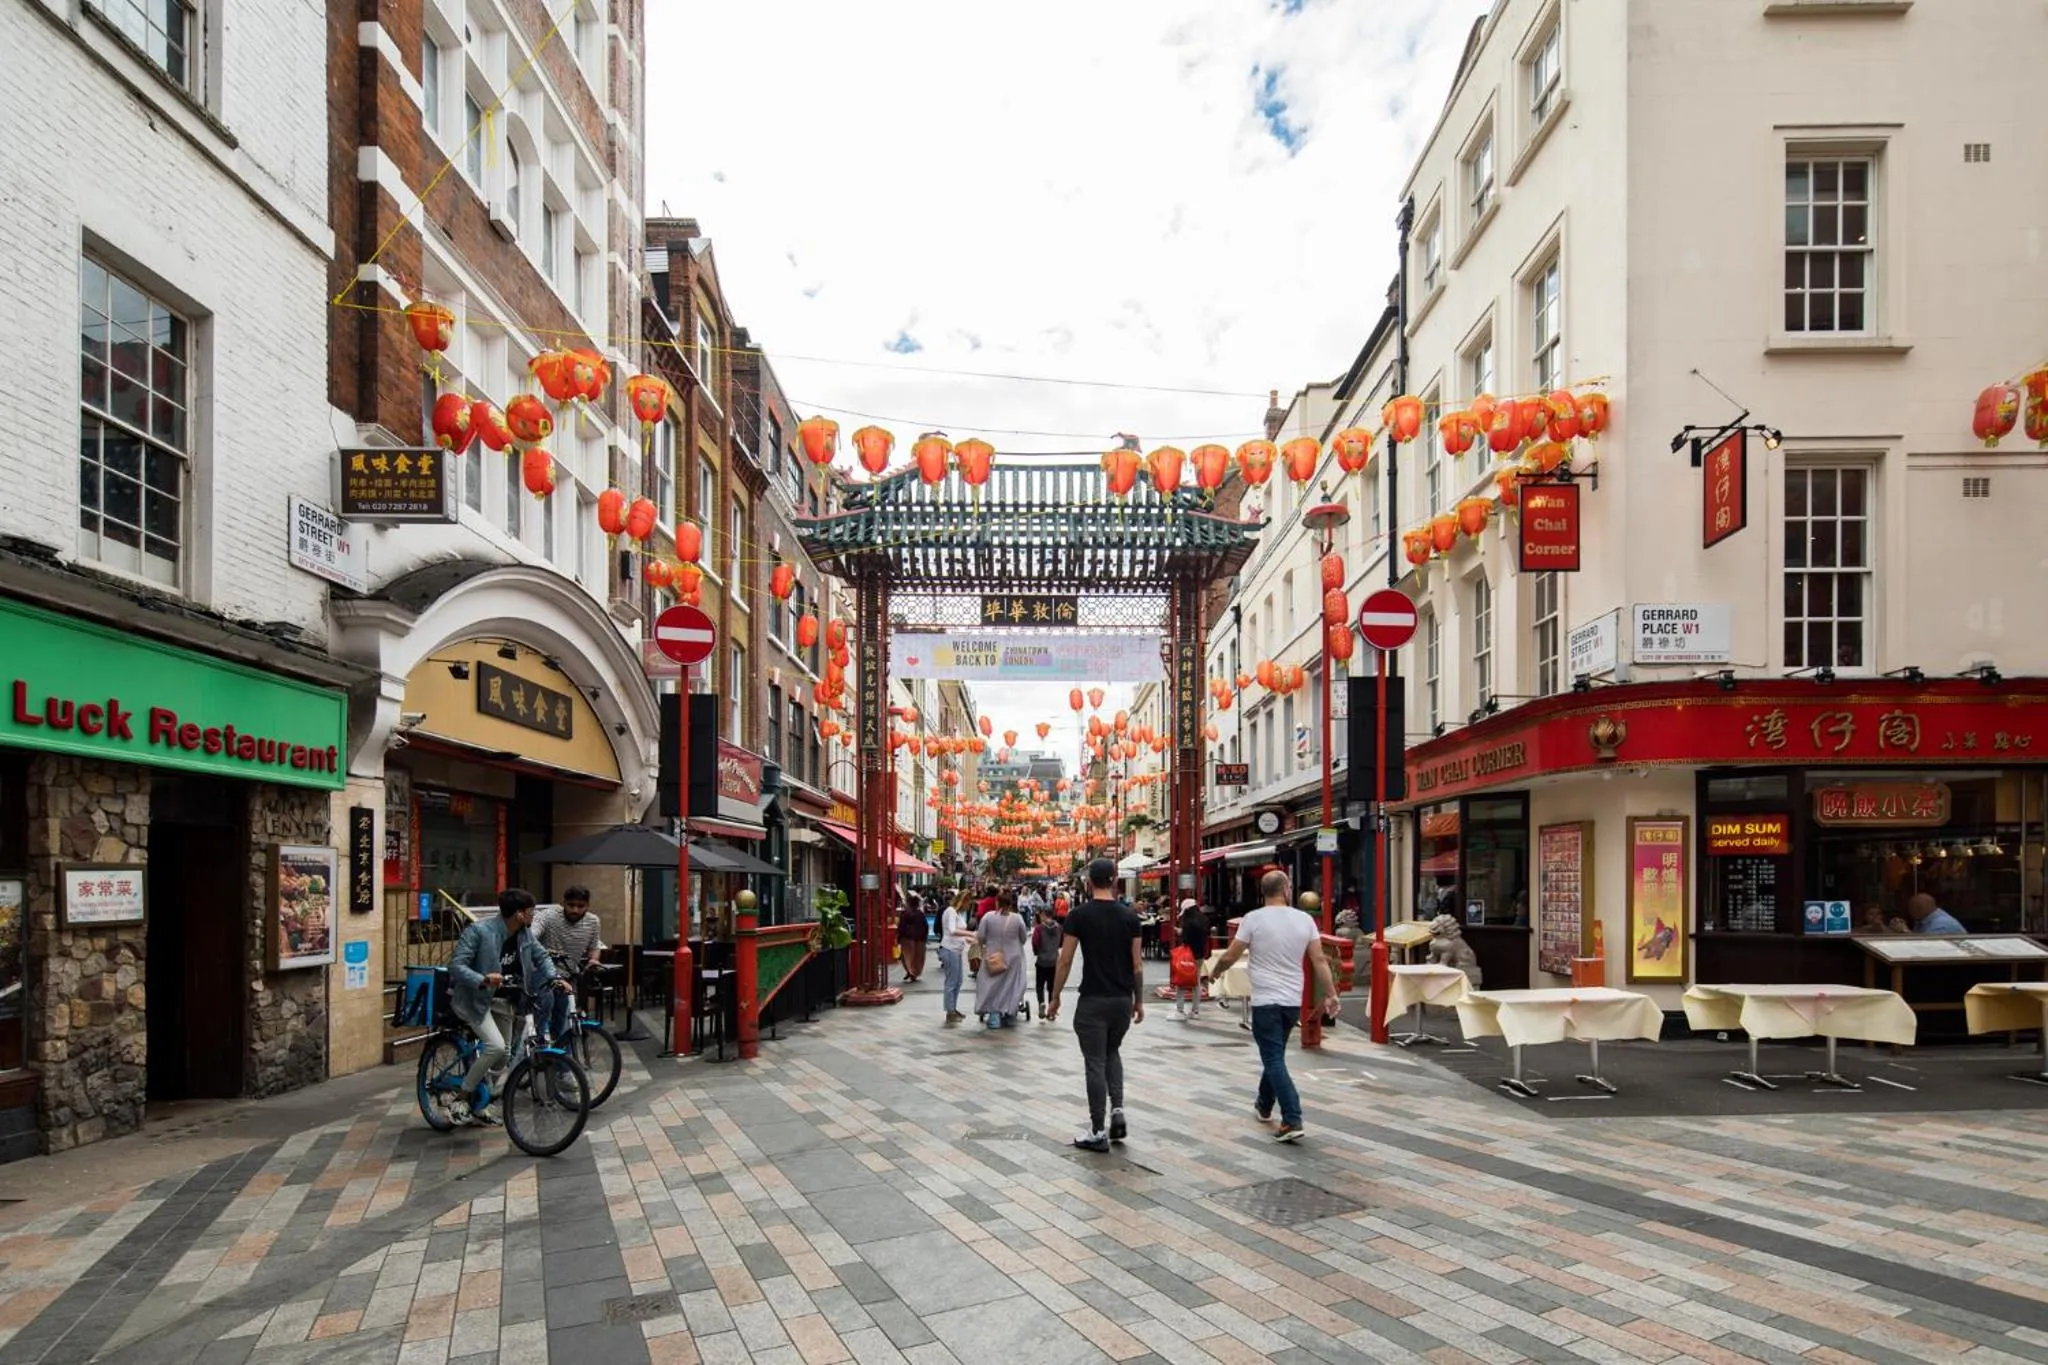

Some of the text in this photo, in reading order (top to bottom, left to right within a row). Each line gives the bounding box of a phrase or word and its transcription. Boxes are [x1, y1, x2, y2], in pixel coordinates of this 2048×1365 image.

[298, 503, 342, 536] GERRARD
[1533, 518, 1567, 531] Chai
[298, 520, 350, 556] STREET W1
[1525, 542, 1576, 555] Corner
[1642, 609, 1698, 621] GERRARD
[1571, 624, 1598, 646] GERRARD
[1642, 623, 1699, 634] PLACE W1
[952, 640, 998, 653] WELCOME
[1571, 639, 1592, 659] STREET
[955, 654, 997, 666] BACK TO
[13, 679, 338, 774] Luck Restaurant
[1441, 758, 1470, 785] CHAI
[1473, 741, 1526, 777] CORNER
[1711, 823, 1781, 835] DIM SUM
[1712, 837, 1780, 848] served daily
[78, 879, 133, 897] 家常菜
